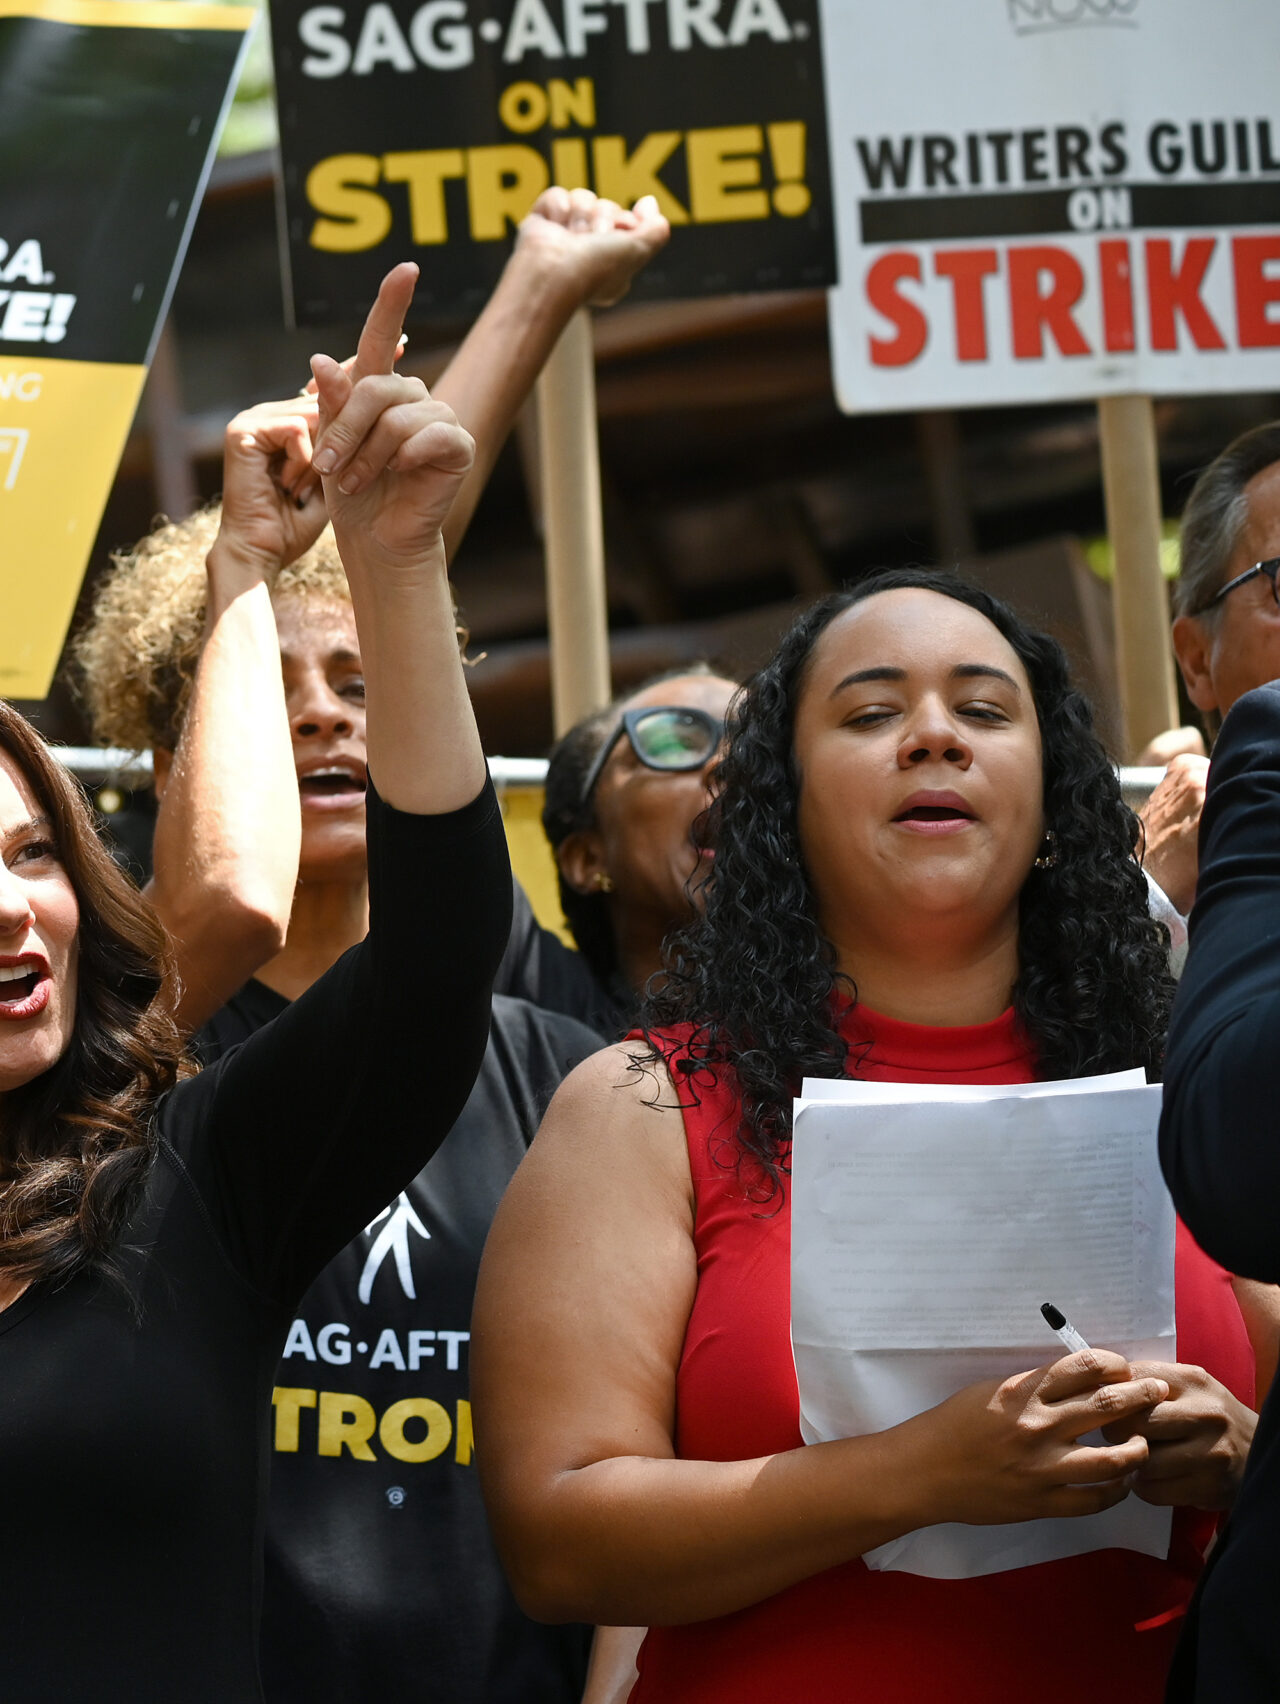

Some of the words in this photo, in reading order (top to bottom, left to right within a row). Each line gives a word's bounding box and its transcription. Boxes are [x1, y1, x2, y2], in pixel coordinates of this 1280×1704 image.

[499, 78, 596, 133] ON
[305, 121, 811, 253] STRIKE!
[856, 121, 1130, 192] WRITERS
[1067, 187, 1132, 232] ON
[864, 235, 1280, 369] STRIKE
